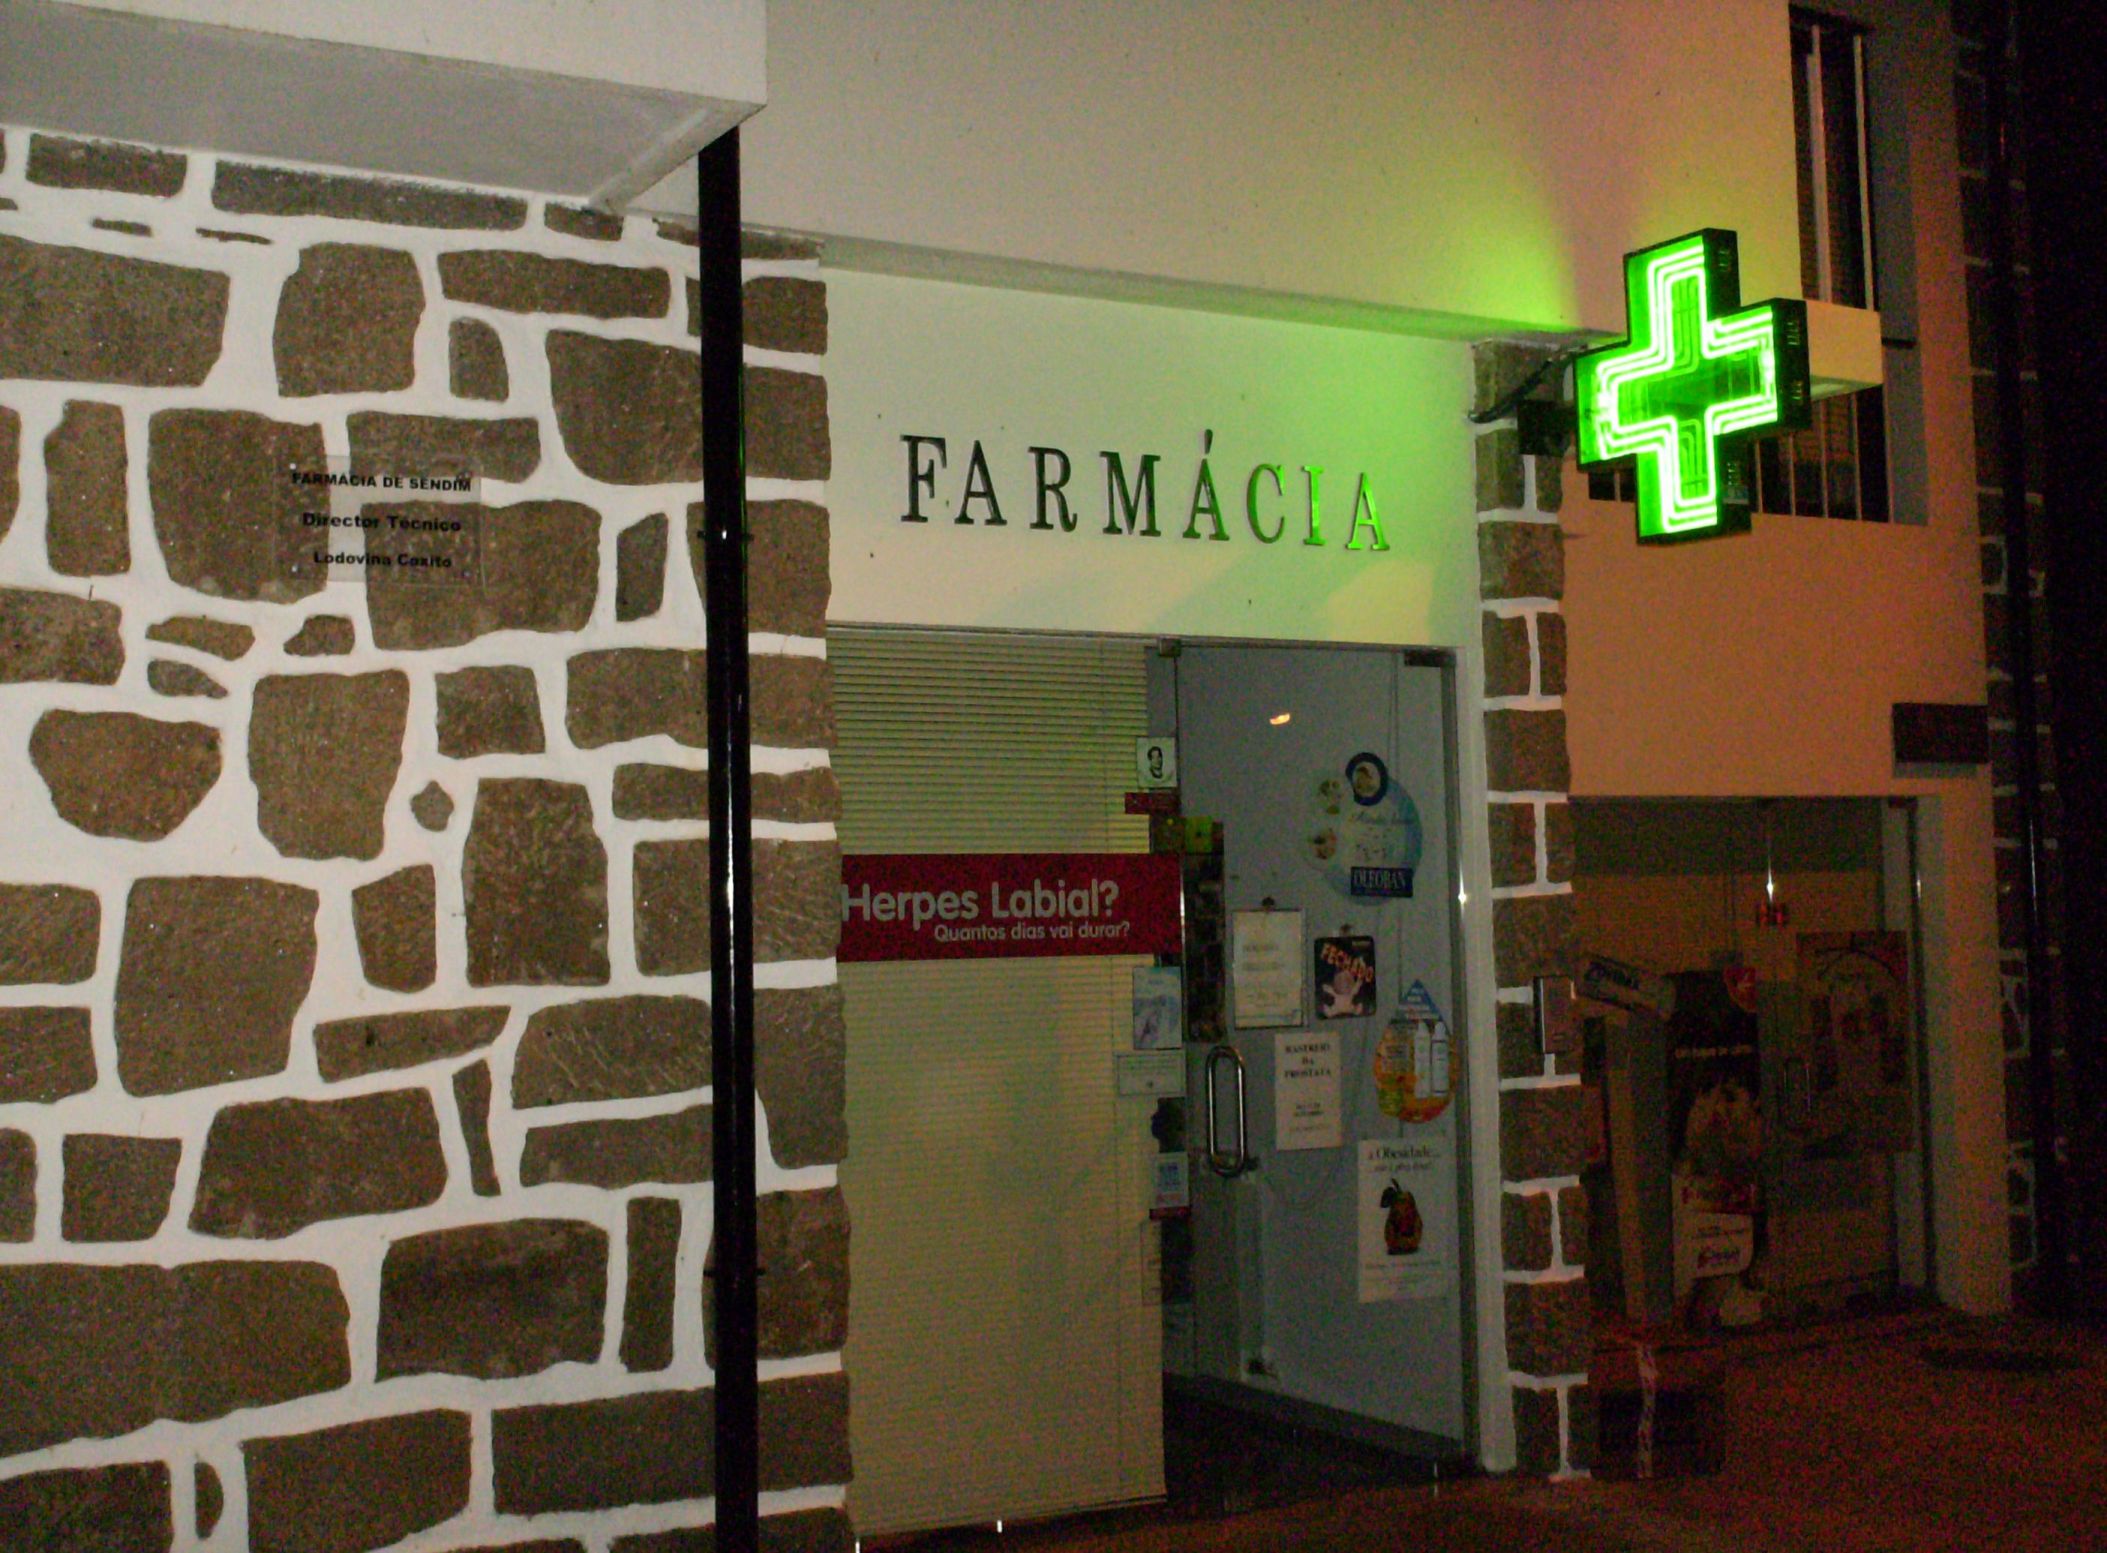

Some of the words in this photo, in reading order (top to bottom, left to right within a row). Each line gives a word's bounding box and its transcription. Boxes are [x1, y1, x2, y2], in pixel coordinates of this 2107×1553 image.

[383, 476, 404, 489] DE
[409, 477, 471, 492] SENDIM
[900, 429, 1391, 551] FARMÁCIA
[302, 512, 379, 529] Director
[313, 551, 391, 566] Lodovina
[841, 882, 980, 931] Herpes
[991, 878, 1119, 918] Labial?
[934, 923, 1006, 943] Quantos
[1011, 921, 1045, 941] dias
[1050, 921, 1074, 939] vai
[1079, 920, 1130, 939] durar?
